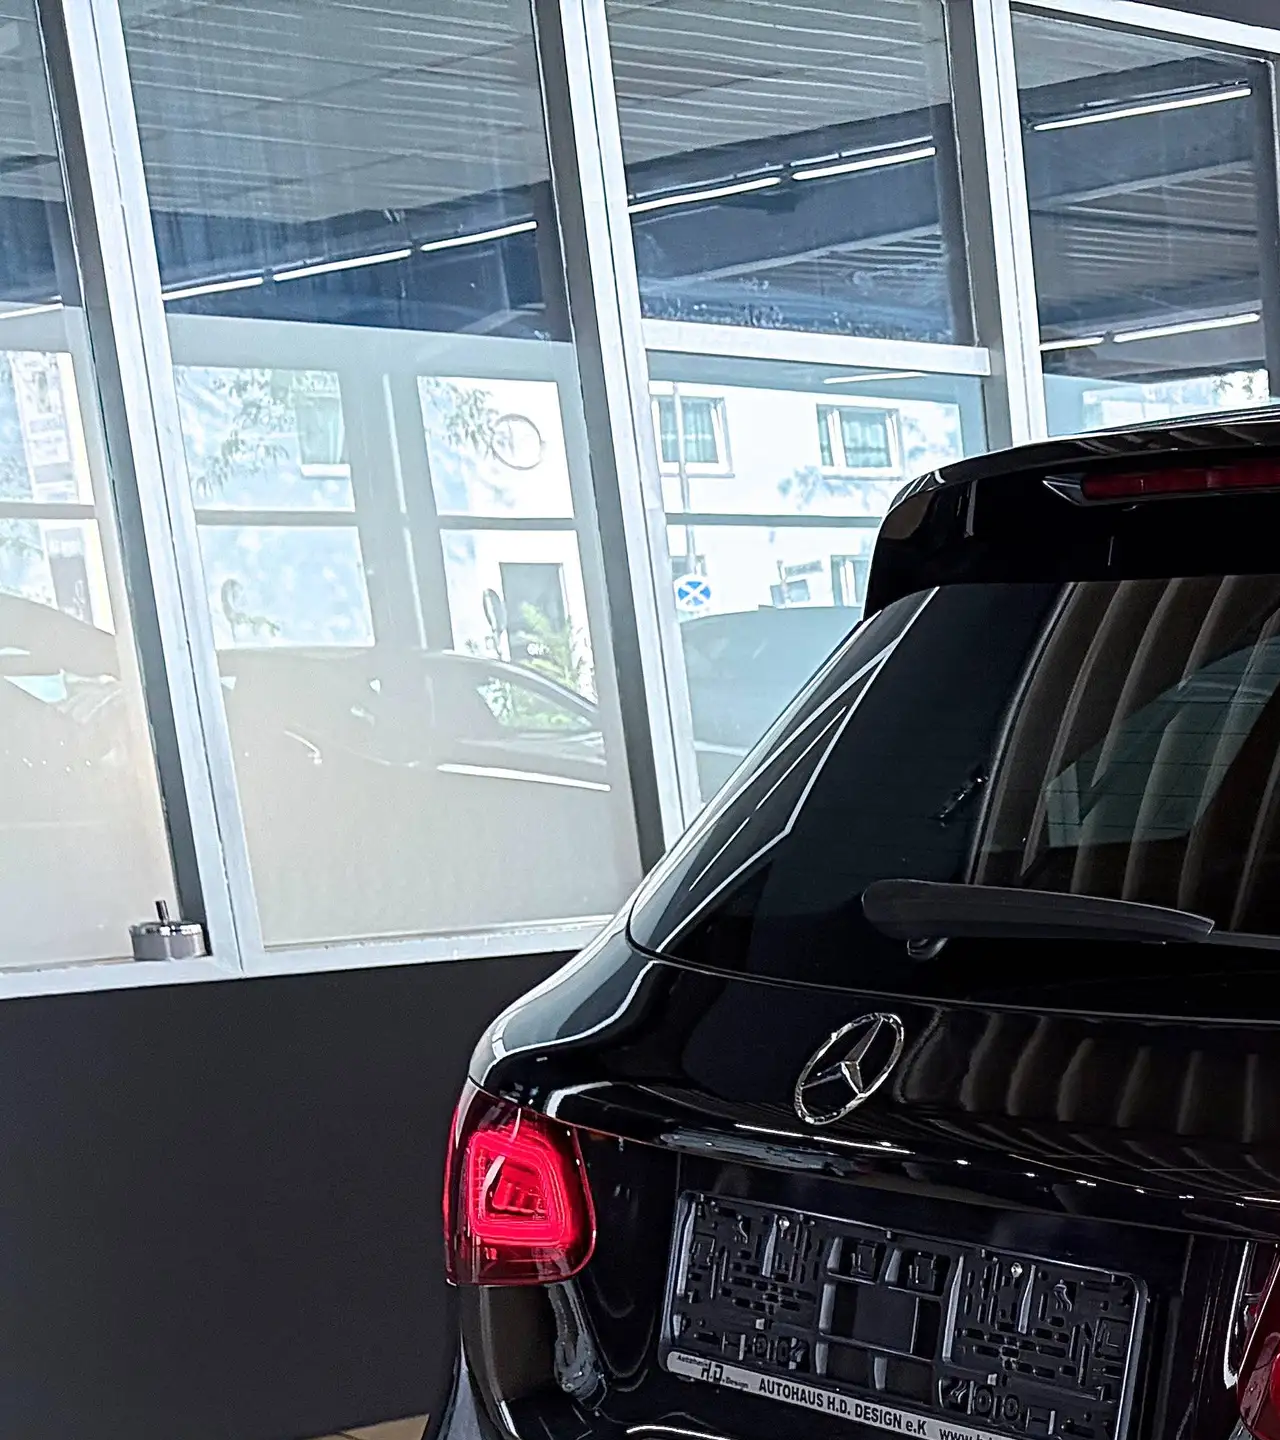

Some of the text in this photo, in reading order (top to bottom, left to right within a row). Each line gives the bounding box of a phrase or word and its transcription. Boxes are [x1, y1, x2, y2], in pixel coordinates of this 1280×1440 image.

[758, 1377, 824, 1408] AUTOHAUS
[827, 1396, 851, 1415] H.D.
[855, 1402, 902, 1430] DESIGN
[905, 1419, 927, 1436] e.K
